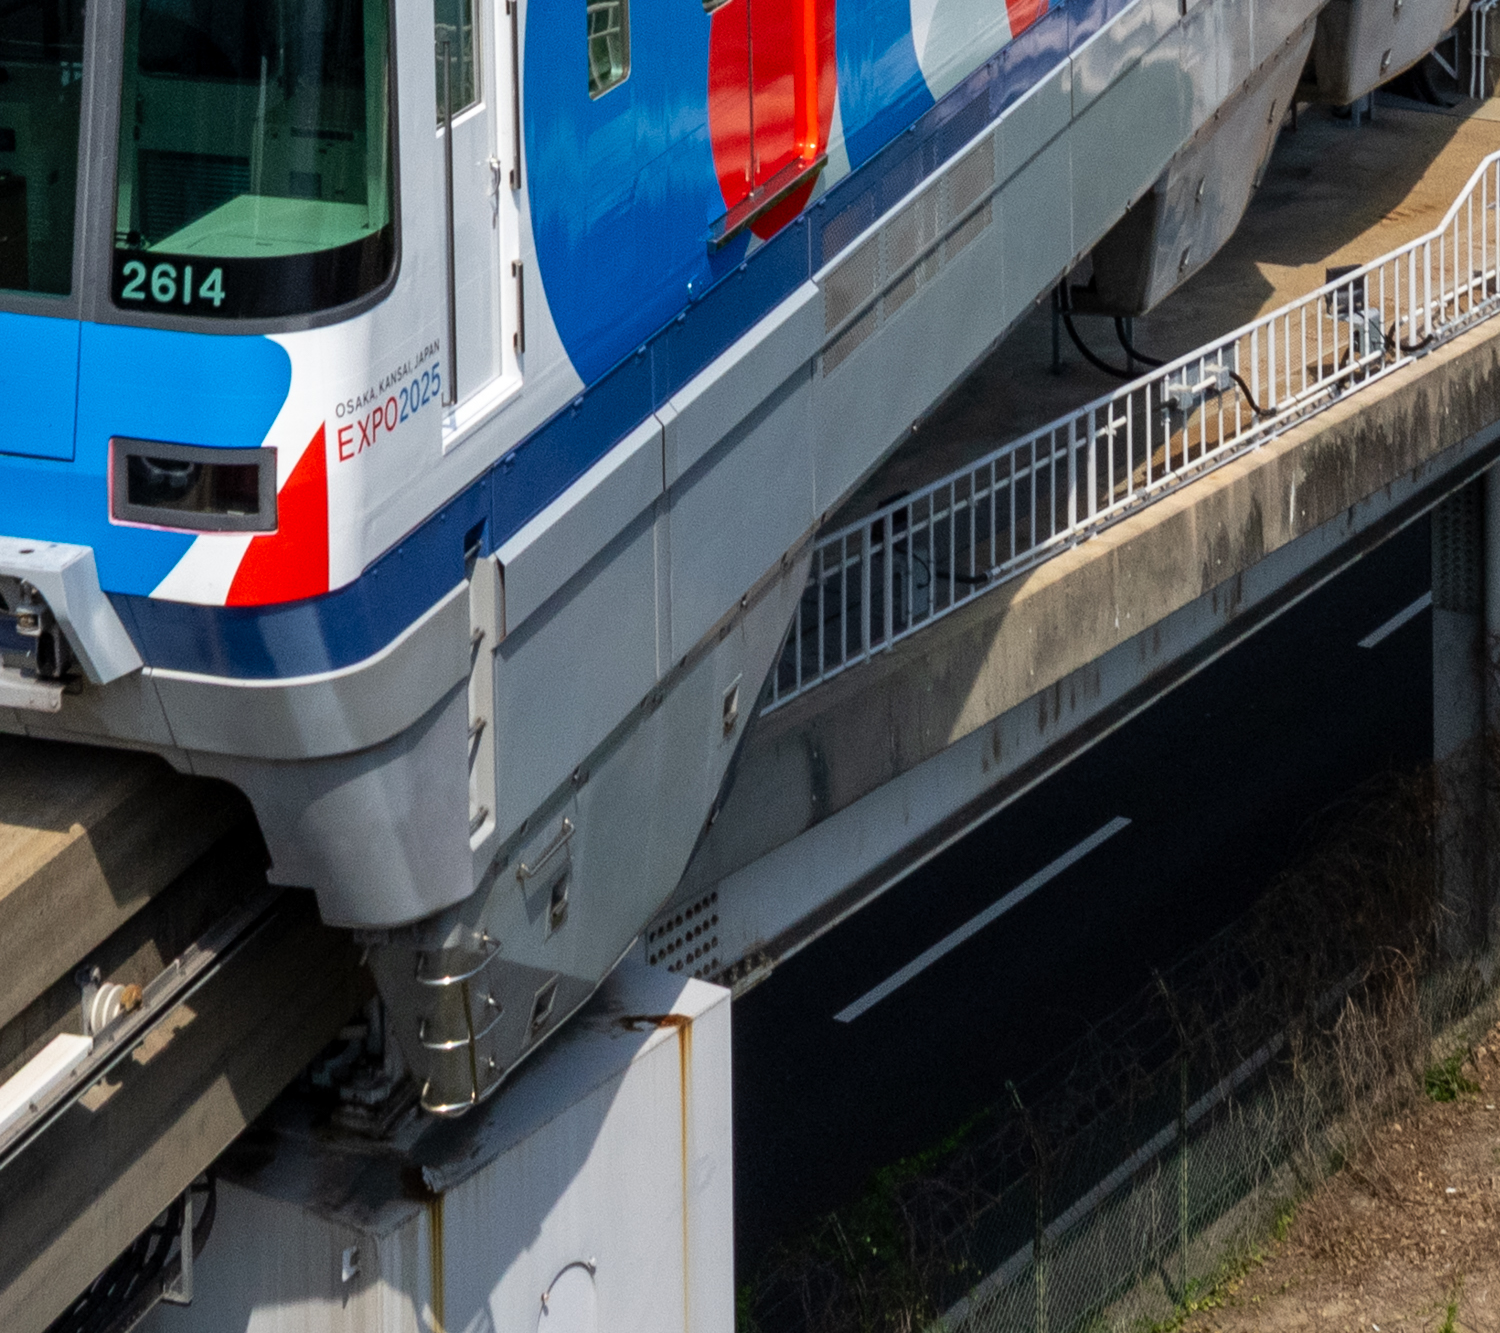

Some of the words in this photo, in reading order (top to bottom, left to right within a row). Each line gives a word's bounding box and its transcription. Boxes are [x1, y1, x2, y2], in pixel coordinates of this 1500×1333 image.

[120, 259, 227, 307] 2614
[335, 387, 378, 418] OSAKA,
[379, 361, 413, 394] KANSAI,
[414, 338, 440, 369] JAPAN
[337, 361, 441, 462] EXPO2025
